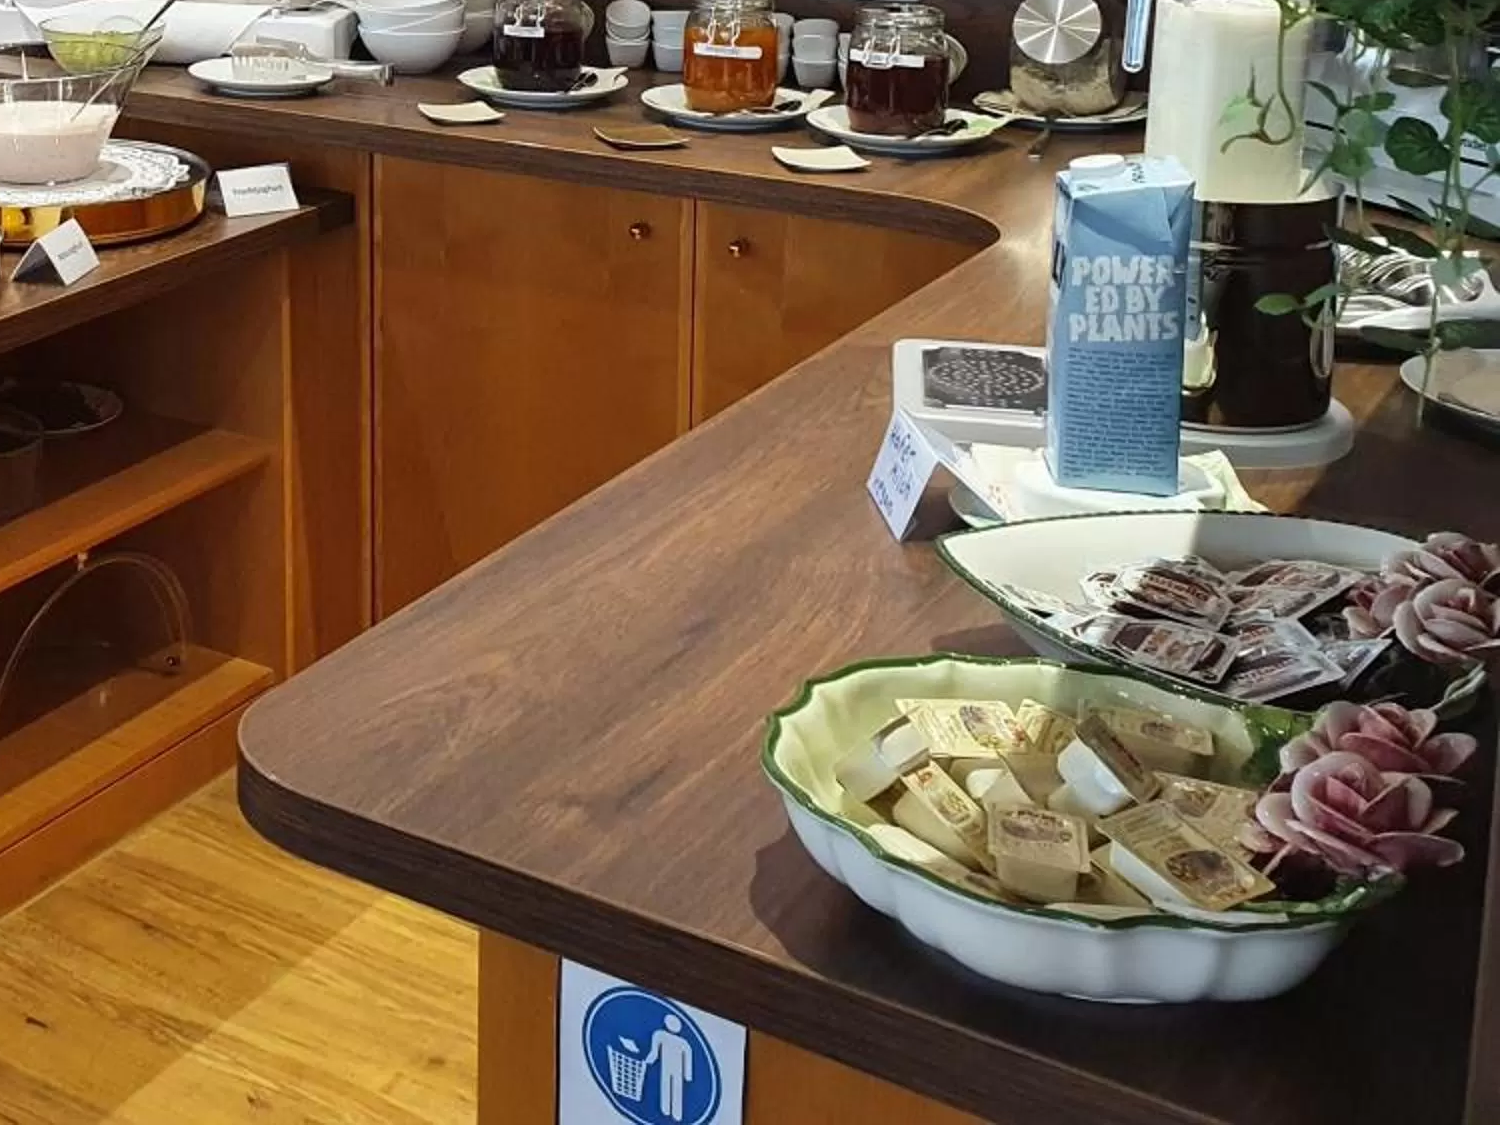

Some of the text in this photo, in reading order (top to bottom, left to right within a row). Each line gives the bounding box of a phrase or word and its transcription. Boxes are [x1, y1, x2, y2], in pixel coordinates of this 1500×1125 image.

[1085, 283, 1165, 313] ED BY
[1068, 311, 1180, 343] PLANTS
